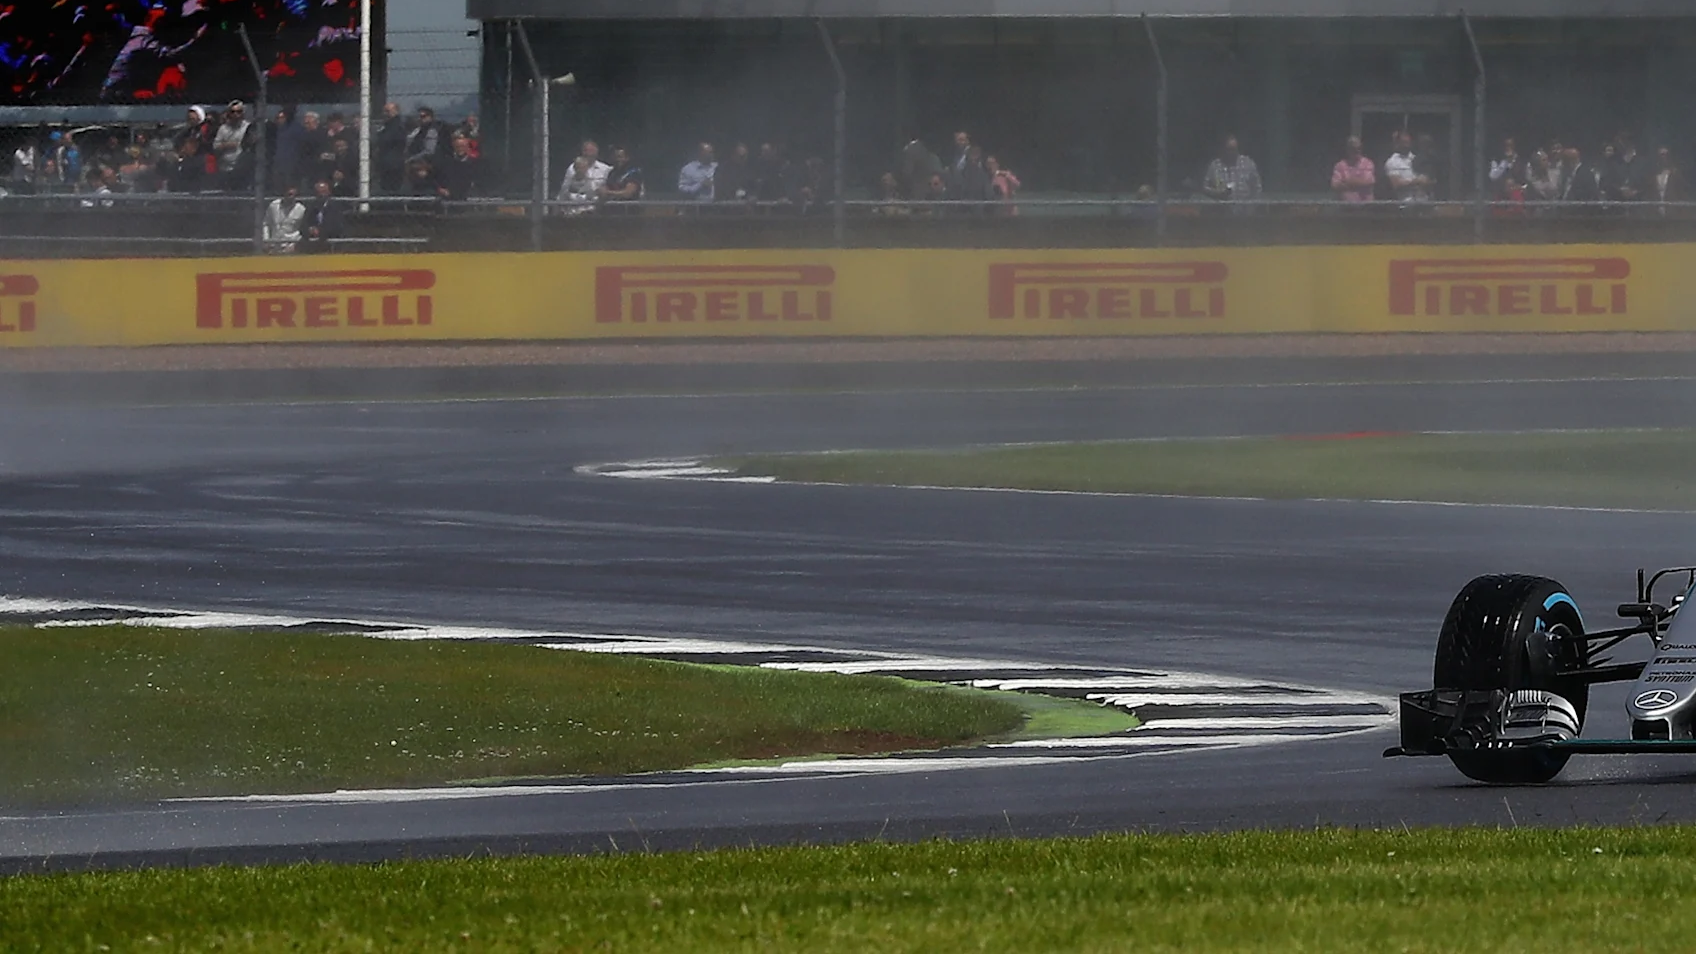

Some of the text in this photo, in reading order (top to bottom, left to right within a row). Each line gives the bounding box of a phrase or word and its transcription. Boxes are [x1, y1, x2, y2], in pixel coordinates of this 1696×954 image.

[195, 268, 437, 329] PIRELLI
[595, 264, 836, 324] PIRELLI
[988, 260, 1229, 320] PIRELLI
[1388, 257, 1631, 316] PIRELLI
